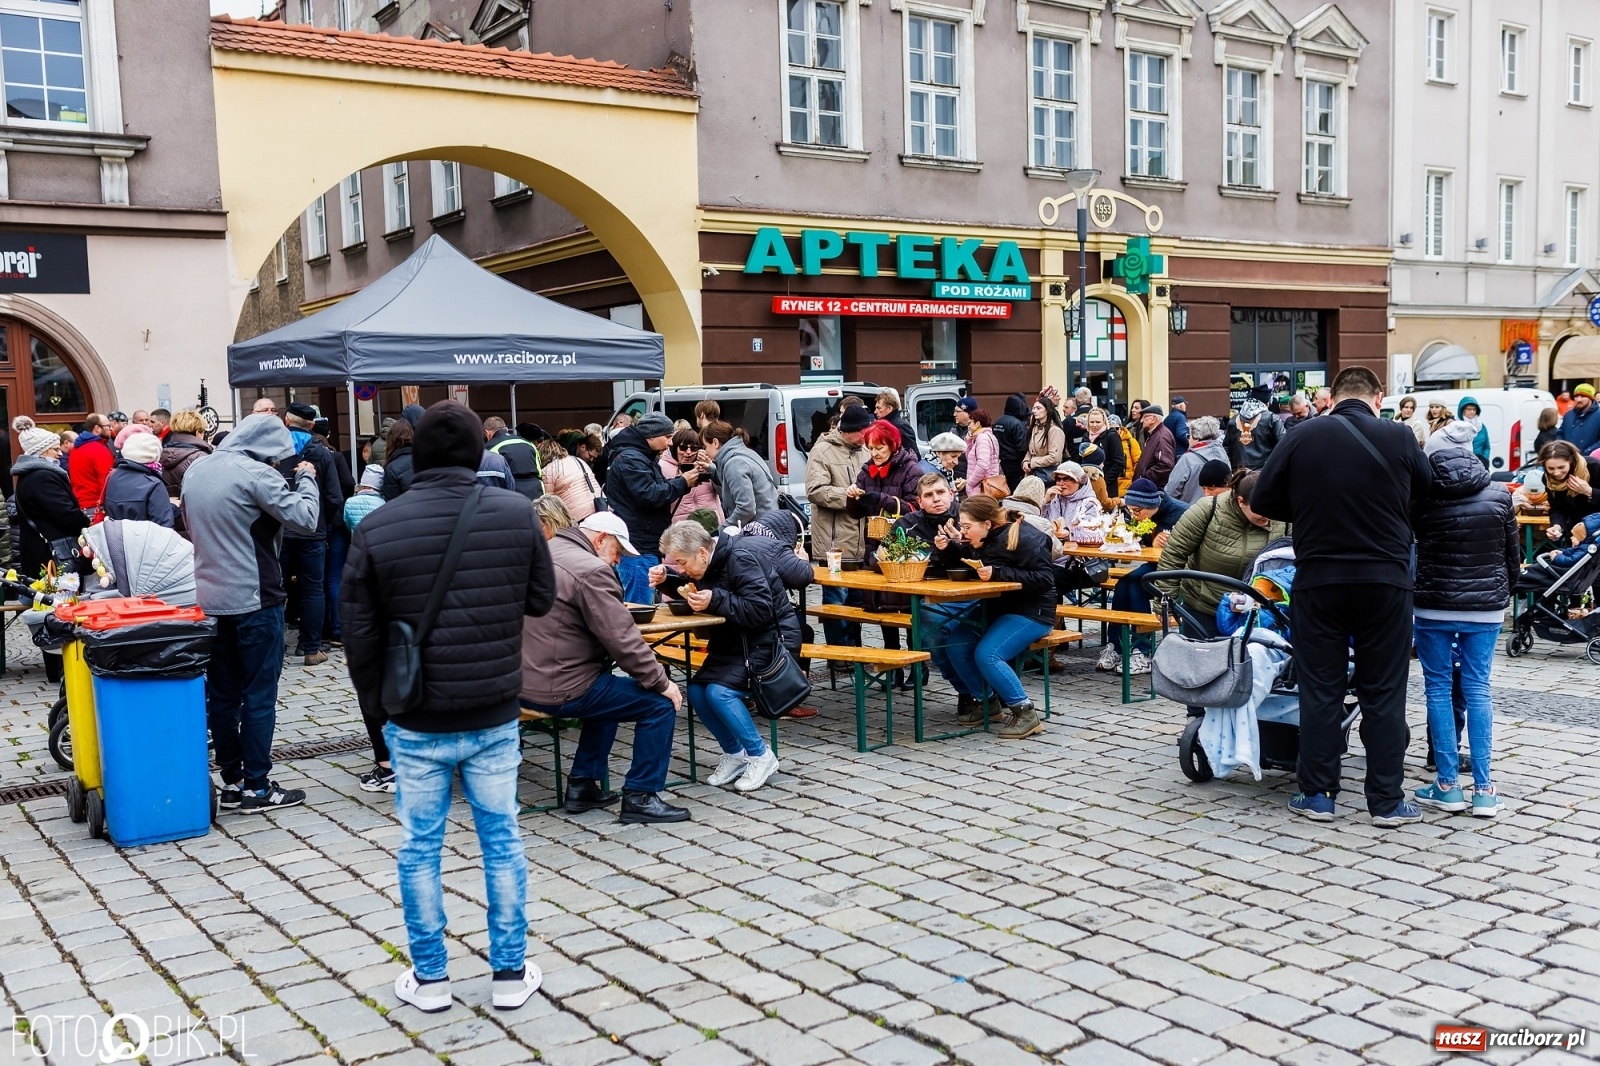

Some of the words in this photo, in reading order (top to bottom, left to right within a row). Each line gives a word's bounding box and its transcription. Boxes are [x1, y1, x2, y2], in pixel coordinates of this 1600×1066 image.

[1095, 203, 1112, 215] 1953
[743, 227, 1030, 283] APTEKA
[941, 285, 969, 296] POD
[974, 285, 1027, 298] RÓŻAMI
[781, 300, 823, 312] RYNEK
[827, 302, 840, 312] 12
[851, 302, 907, 314] CENTRUM
[909, 304, 1007, 317] FARMACEUTYCZNE
[259, 354, 307, 370] www.raciborz.pl
[454, 350, 577, 366] www.raciborz.pl
